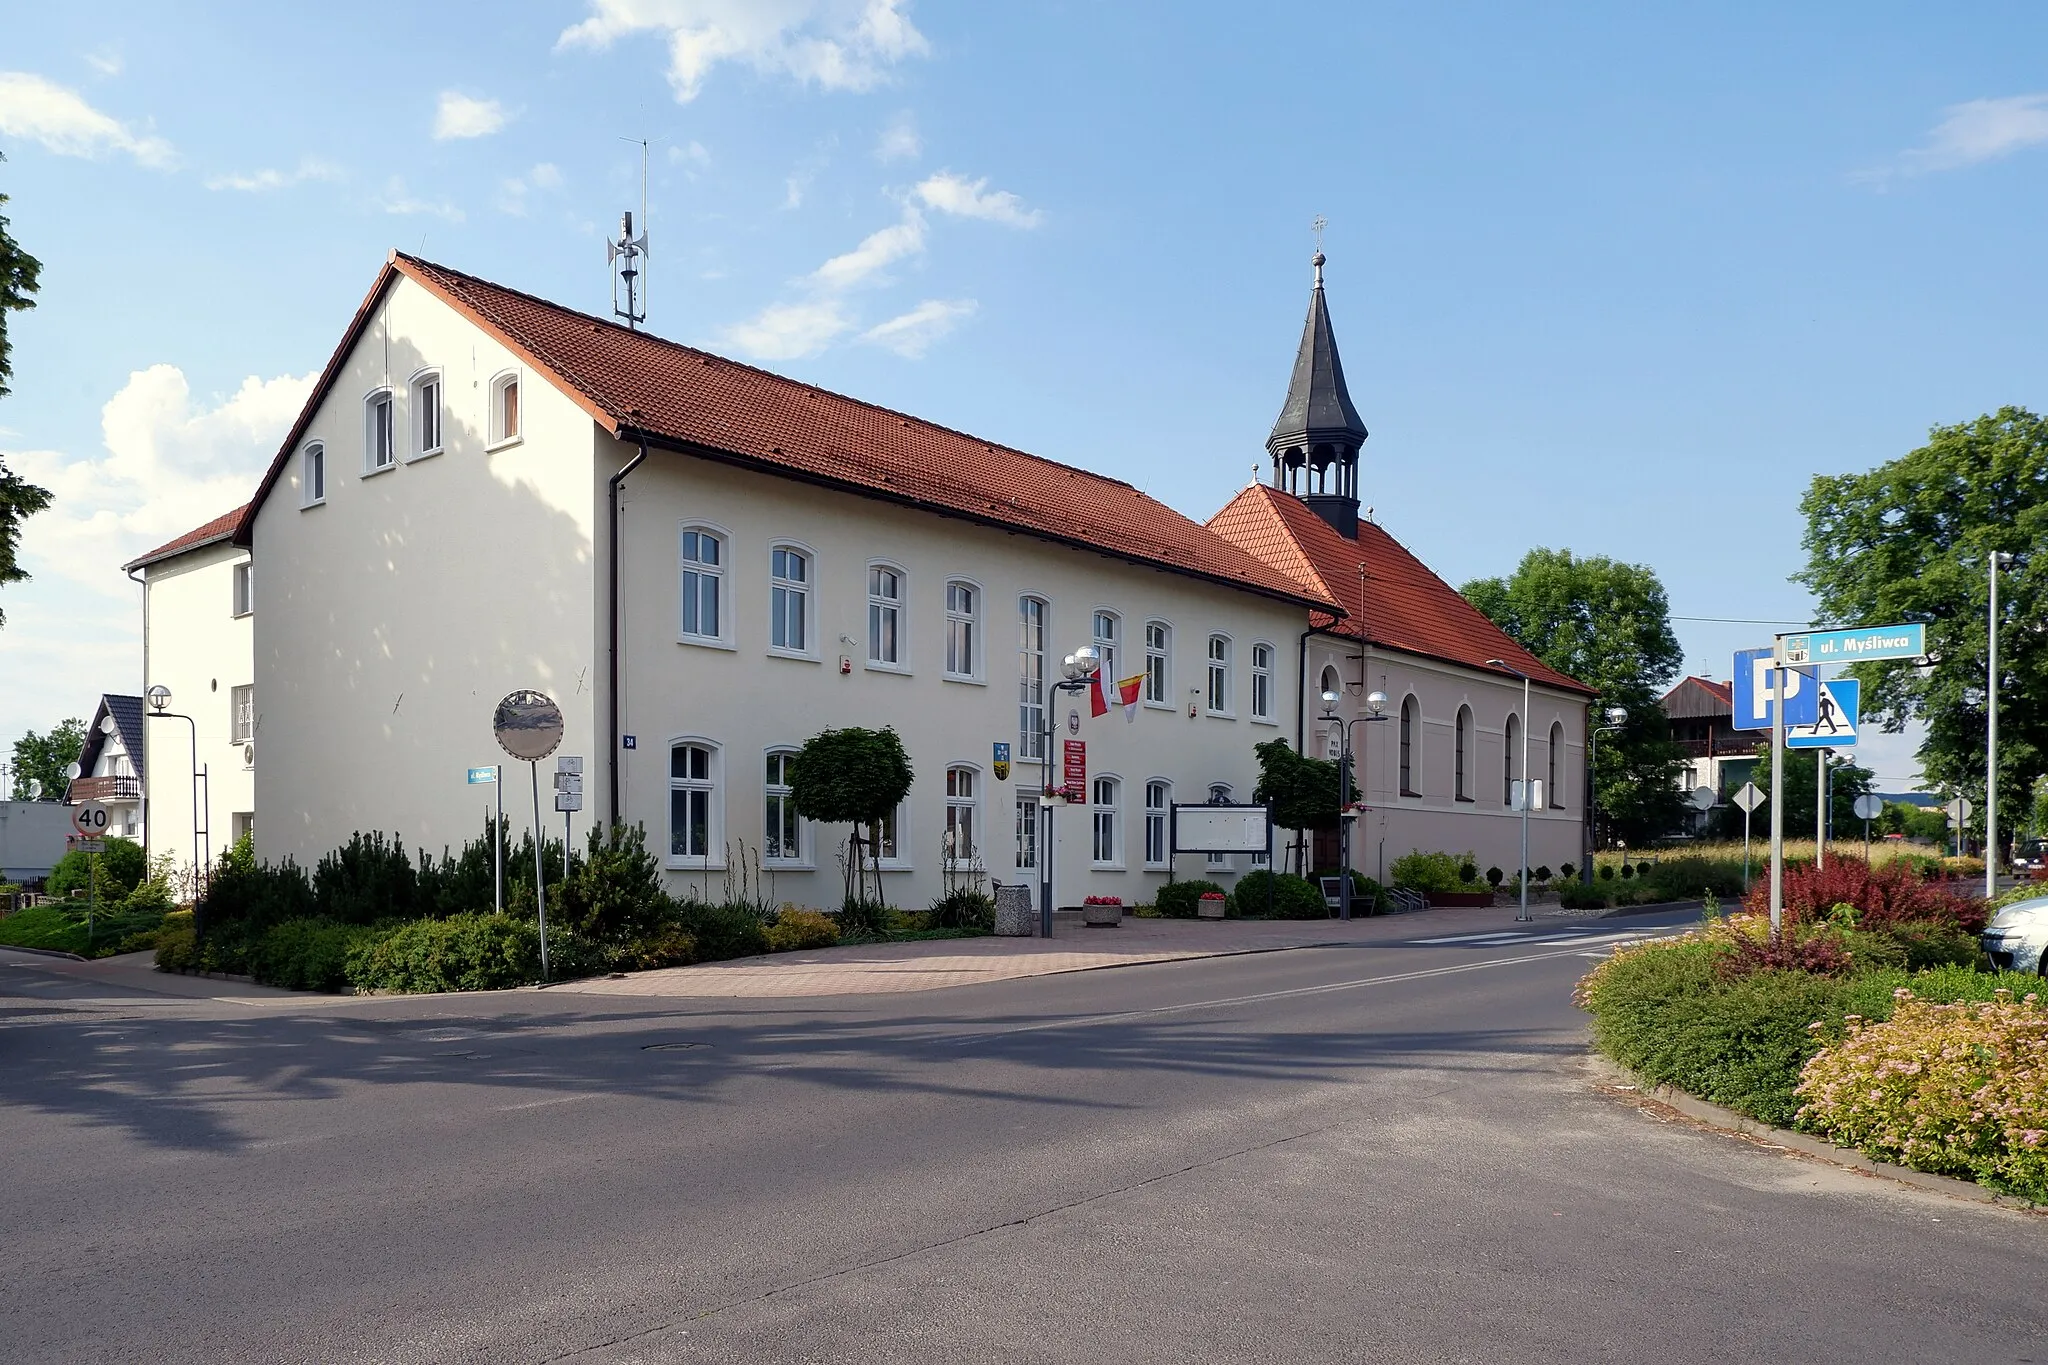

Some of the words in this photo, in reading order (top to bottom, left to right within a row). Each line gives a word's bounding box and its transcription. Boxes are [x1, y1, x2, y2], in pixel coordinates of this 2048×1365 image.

[1820, 639, 1838, 654] ul.
[1844, 636, 1909, 654] Myśliwca
[1753, 656, 1800, 719] P
[626, 737, 634, 747] 34
[79, 809, 106, 827] 40
